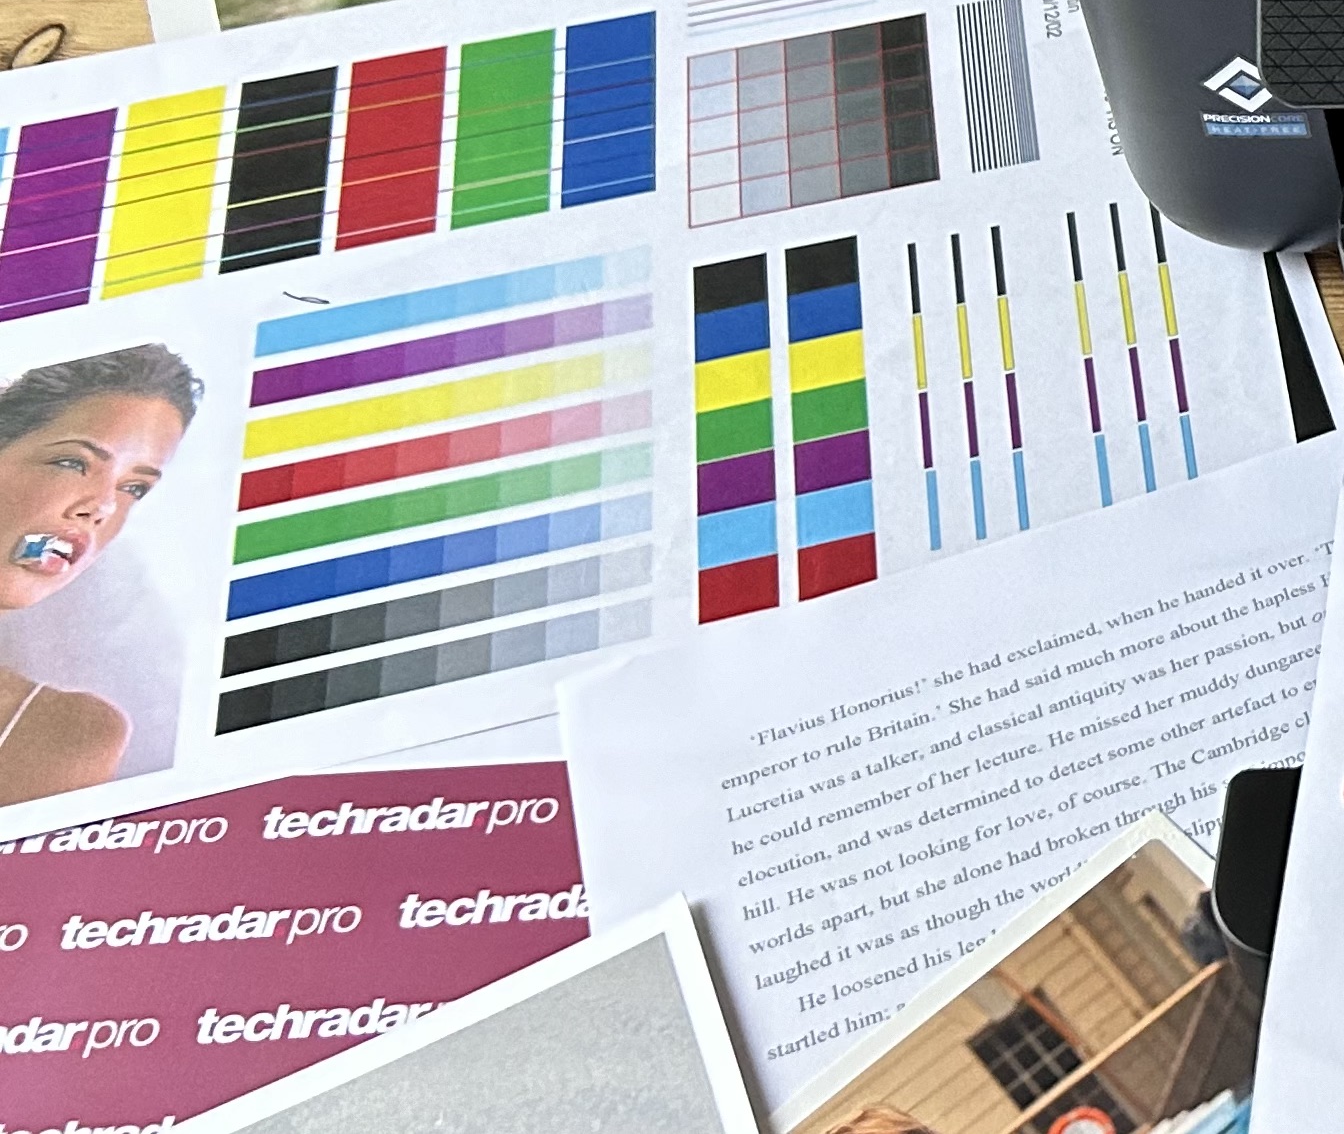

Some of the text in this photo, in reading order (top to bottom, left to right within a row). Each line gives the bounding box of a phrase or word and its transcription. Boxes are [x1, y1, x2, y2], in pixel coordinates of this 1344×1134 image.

[721, 756, 799, 791] emperor
[802, 750, 822, 764] to
[826, 735, 862, 757] rule
[948, 696, 982, 716] She
[986, 678, 1021, 703] had
[1025, 664, 1063, 689] said
[1066, 649, 1116, 676] much
[1119, 635, 1166, 659] more
[1170, 615, 1220, 641] about
[1221, 606, 1250, 623] the
[1252, 582, 1317, 613] hapless
[726, 615, 1308, 824] Lucretia was a talker, and classical antiquity was her passion, but
[933, 670, 965, 688] she
[967, 653, 1003, 677] had
[1007, 622, 1104, 664] exclaimed,
[1105, 607, 1155, 630] when
[1157, 598, 1180, 613] he
[1183, 572, 1247, 605] handed
[1250, 567, 1264, 582] it
[1267, 554, 1311, 576] over.
[731, 840, 755, 856] he
[759, 816, 813, 847] could
[817, 786, 913, 828] remember
[916, 773, 937, 792] of
[939, 765, 971, 786] her
[975, 744, 1044, 774] lecture.
[1047, 730, 1076, 749] He
[1079, 704, 1143, 738] missed
[1145, 696, 1175, 716] her
[1179, 673, 1240, 704] muddy
[738, 687, 1299, 888] elocution, and was determined to detect some other artefact to
[742, 897, 781, 922] hill.
[787, 887, 815, 907] He
[820, 874, 859, 894] was
[863, 860, 895, 882] not
[898, 835, 972, 870] looking
[975, 823, 1003, 843] for
[1006, 808, 1054, 832] love,
[1057, 792, 1079, 813] of
[1083, 775, 1148, 805] course.
[1149, 759, 1187, 780] The
[1191, 723, 1290, 765] Cambridge
